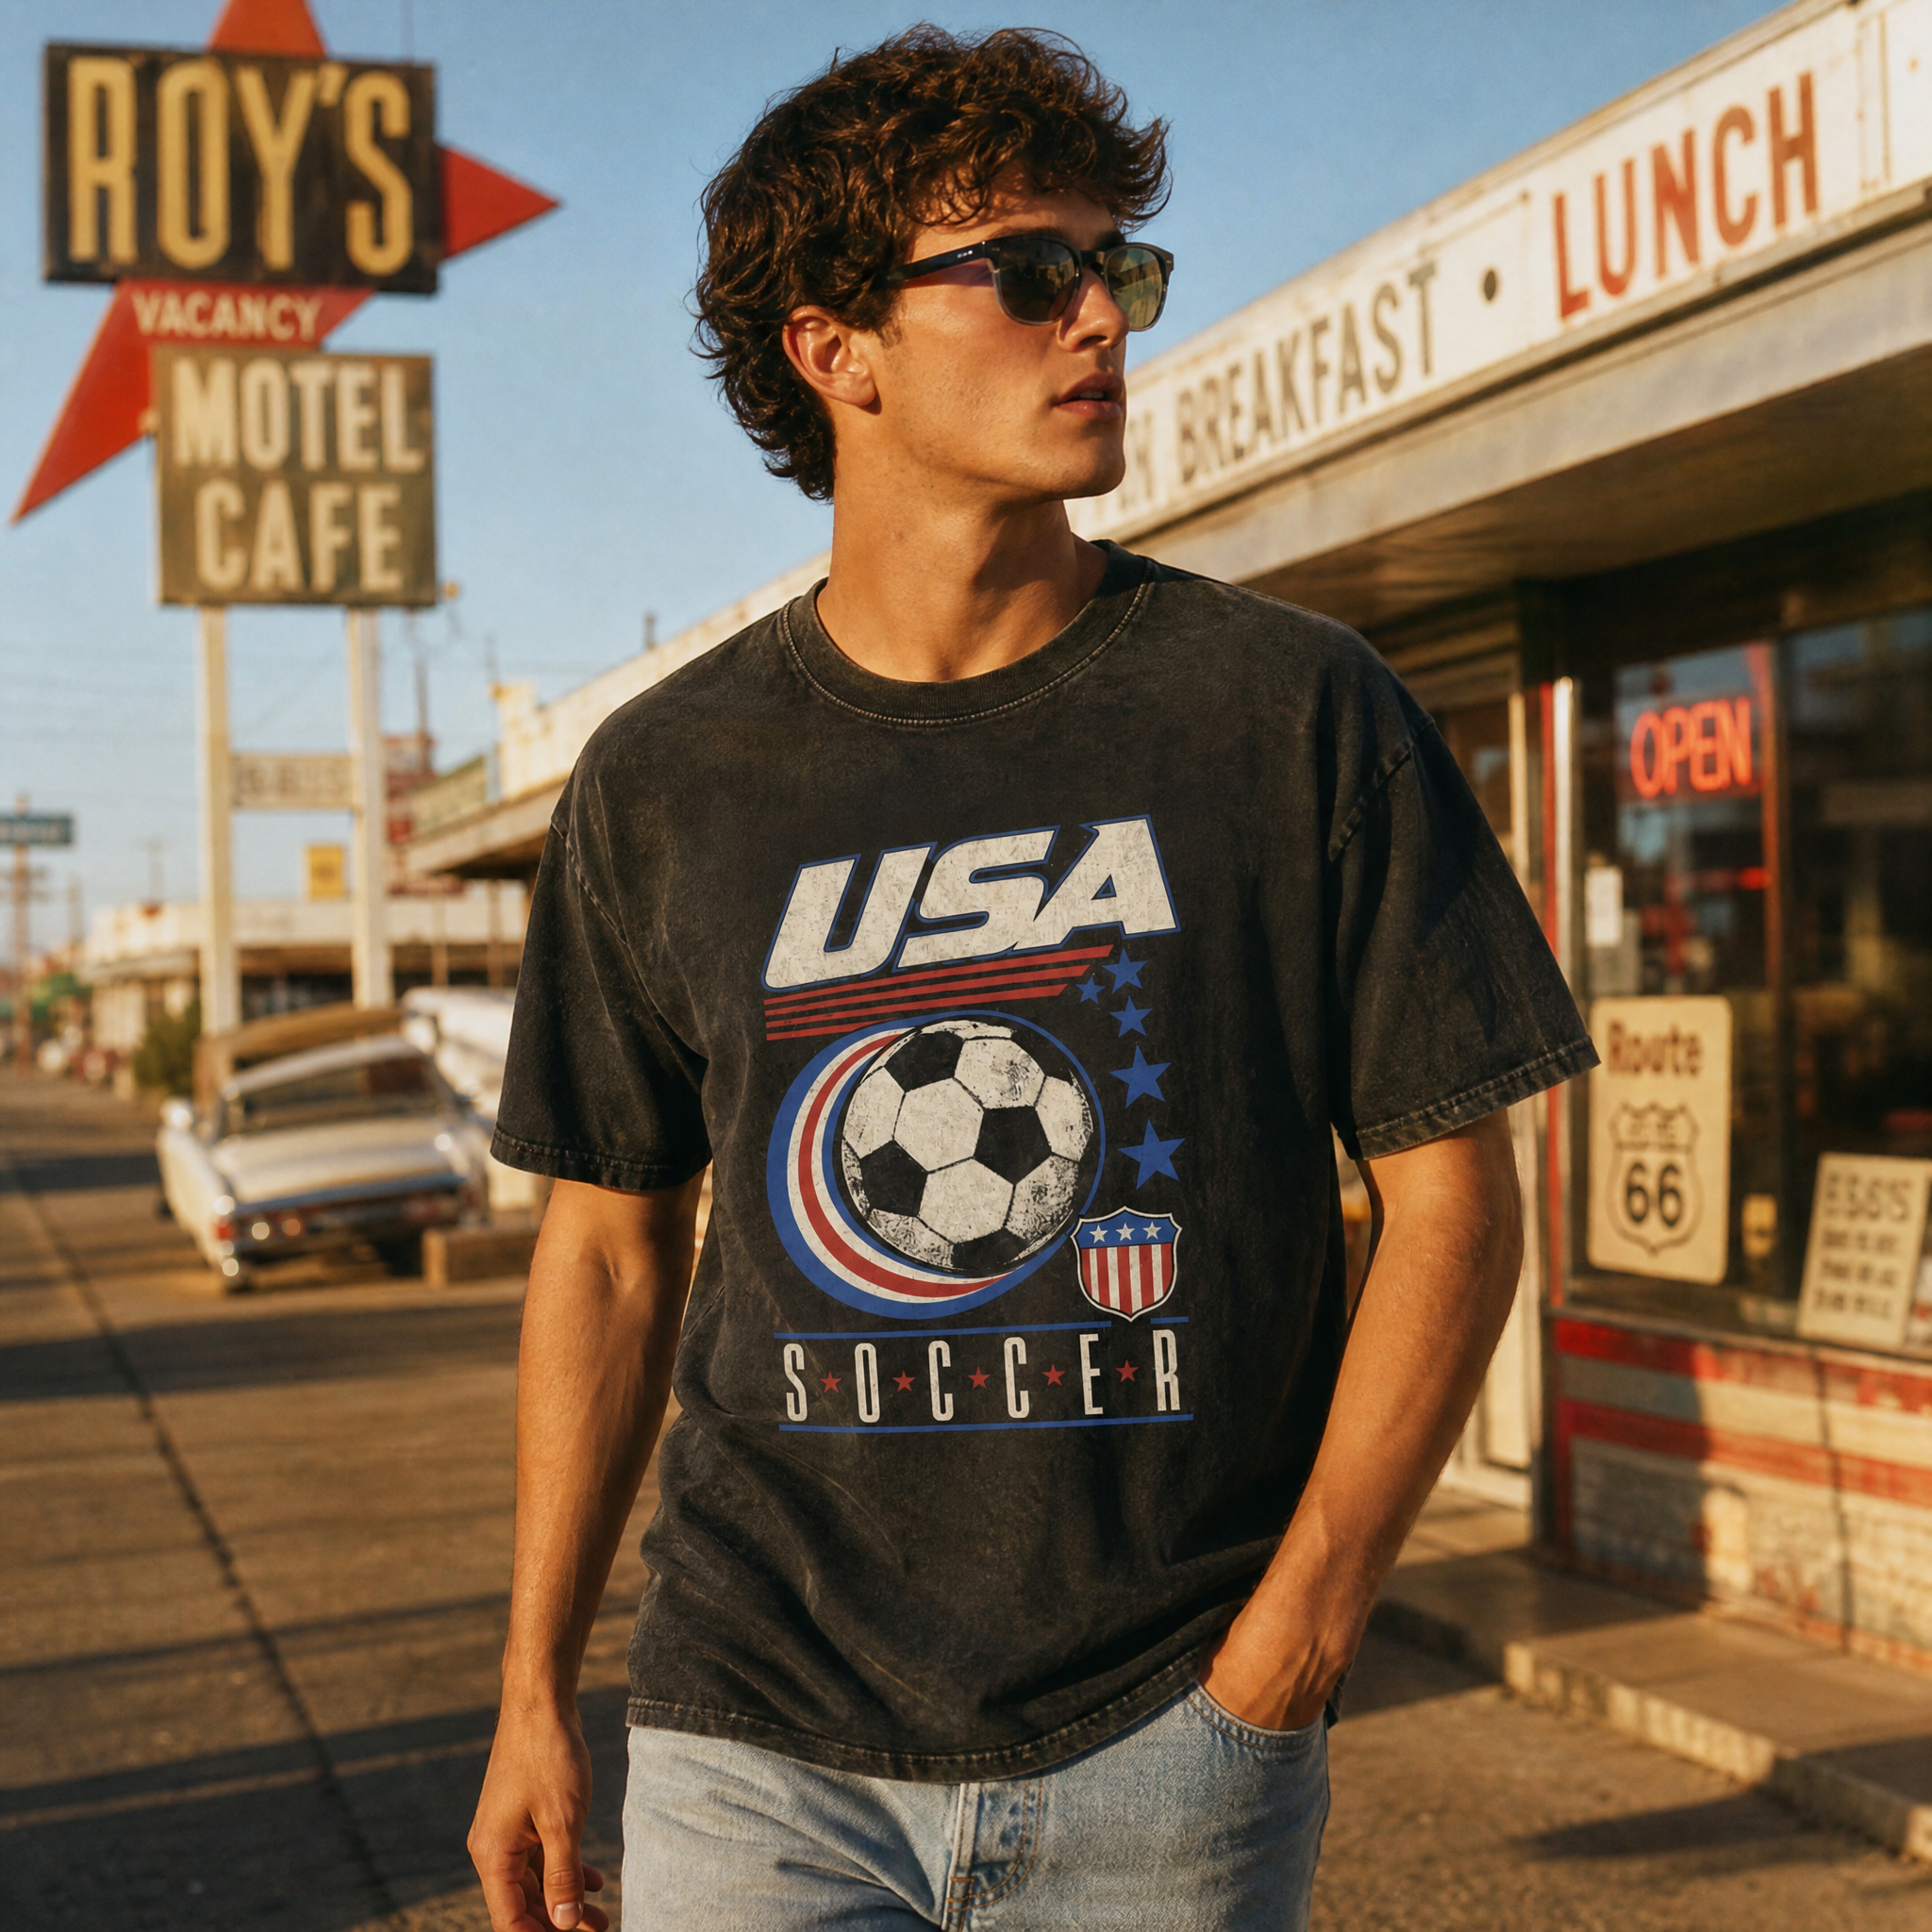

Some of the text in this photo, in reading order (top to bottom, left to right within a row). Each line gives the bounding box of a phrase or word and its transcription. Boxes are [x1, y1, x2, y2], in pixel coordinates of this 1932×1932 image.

[67, 55, 415, 276] ROY'S
[1554, 70, 1819, 319] LUNCH
[131, 291, 324, 341] VACANCY
[1176, 261, 1439, 485] BREAKFAST
[172, 358, 426, 472] MOTEL
[194, 478, 404, 593] CAFE
[1629, 696, 1753, 798] OPEN
[761, 814, 1181, 991] USA
[1607, 1019, 1704, 1074] Route
[1625, 1161, 1684, 1227] 66
[782, 1328, 1181, 1424] SOCCER
